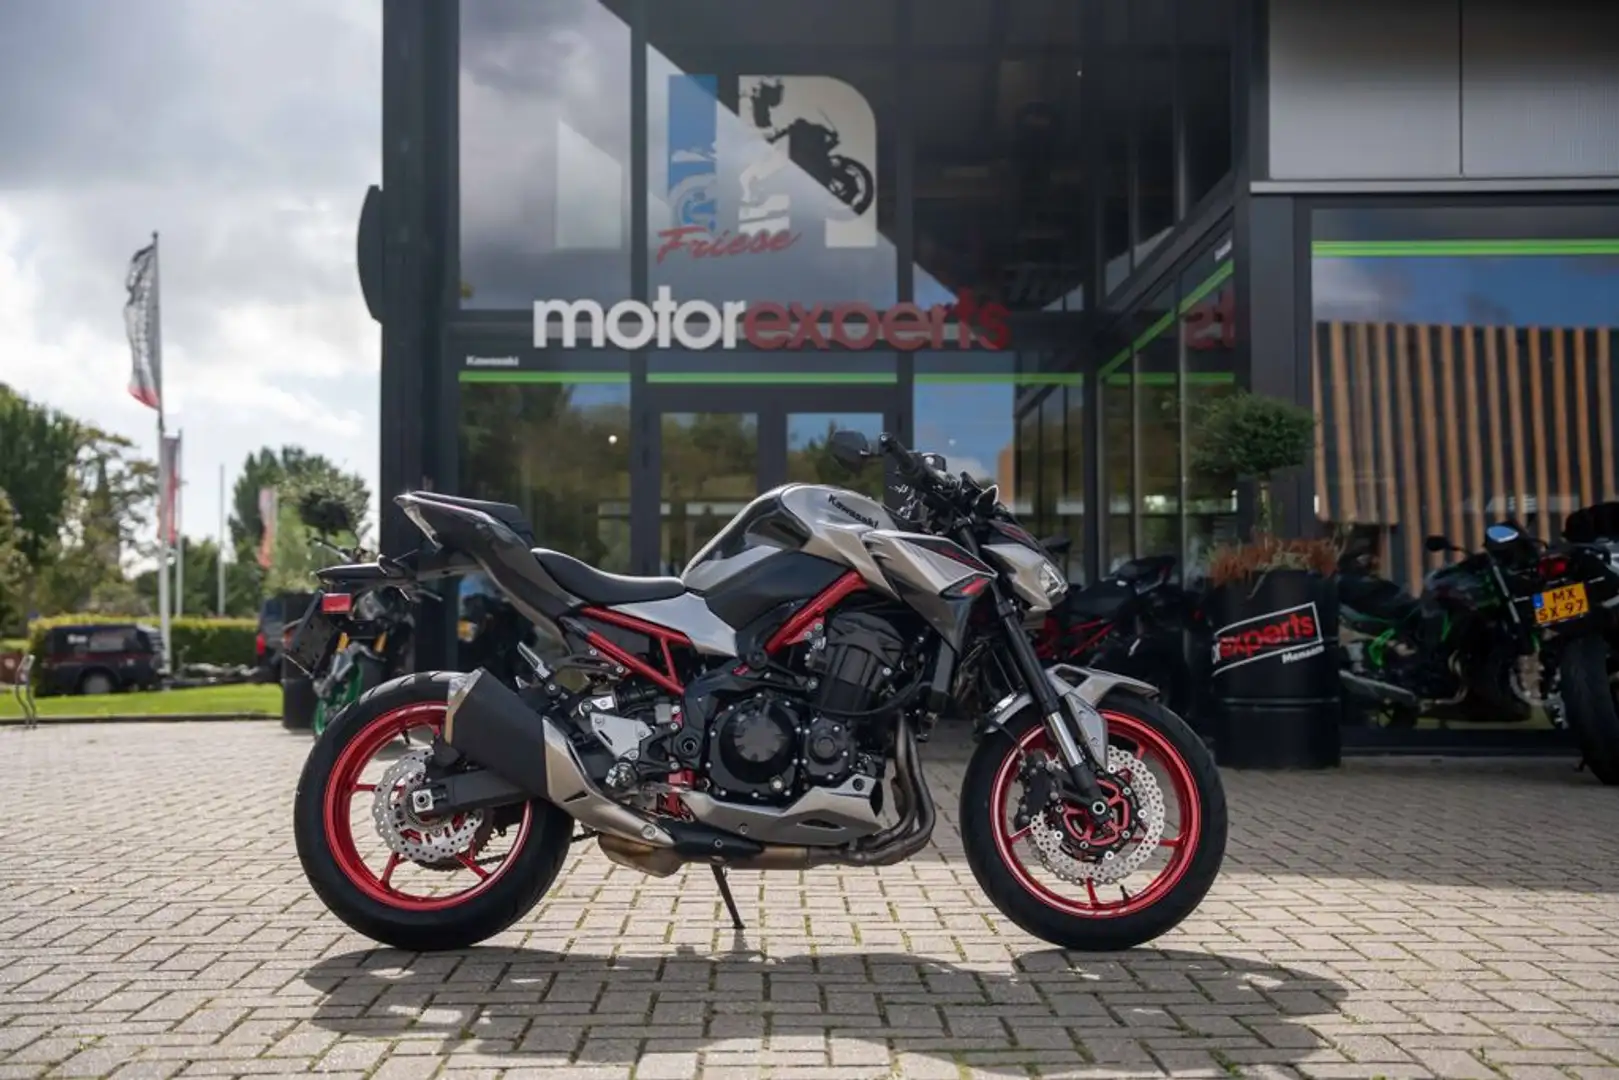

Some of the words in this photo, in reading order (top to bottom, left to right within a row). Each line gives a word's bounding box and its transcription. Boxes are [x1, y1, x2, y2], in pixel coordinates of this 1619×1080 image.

[658, 227, 802, 264] Friese
[828, 494, 879, 529] Kawasaki
[1553, 588, 1576, 603] MX
